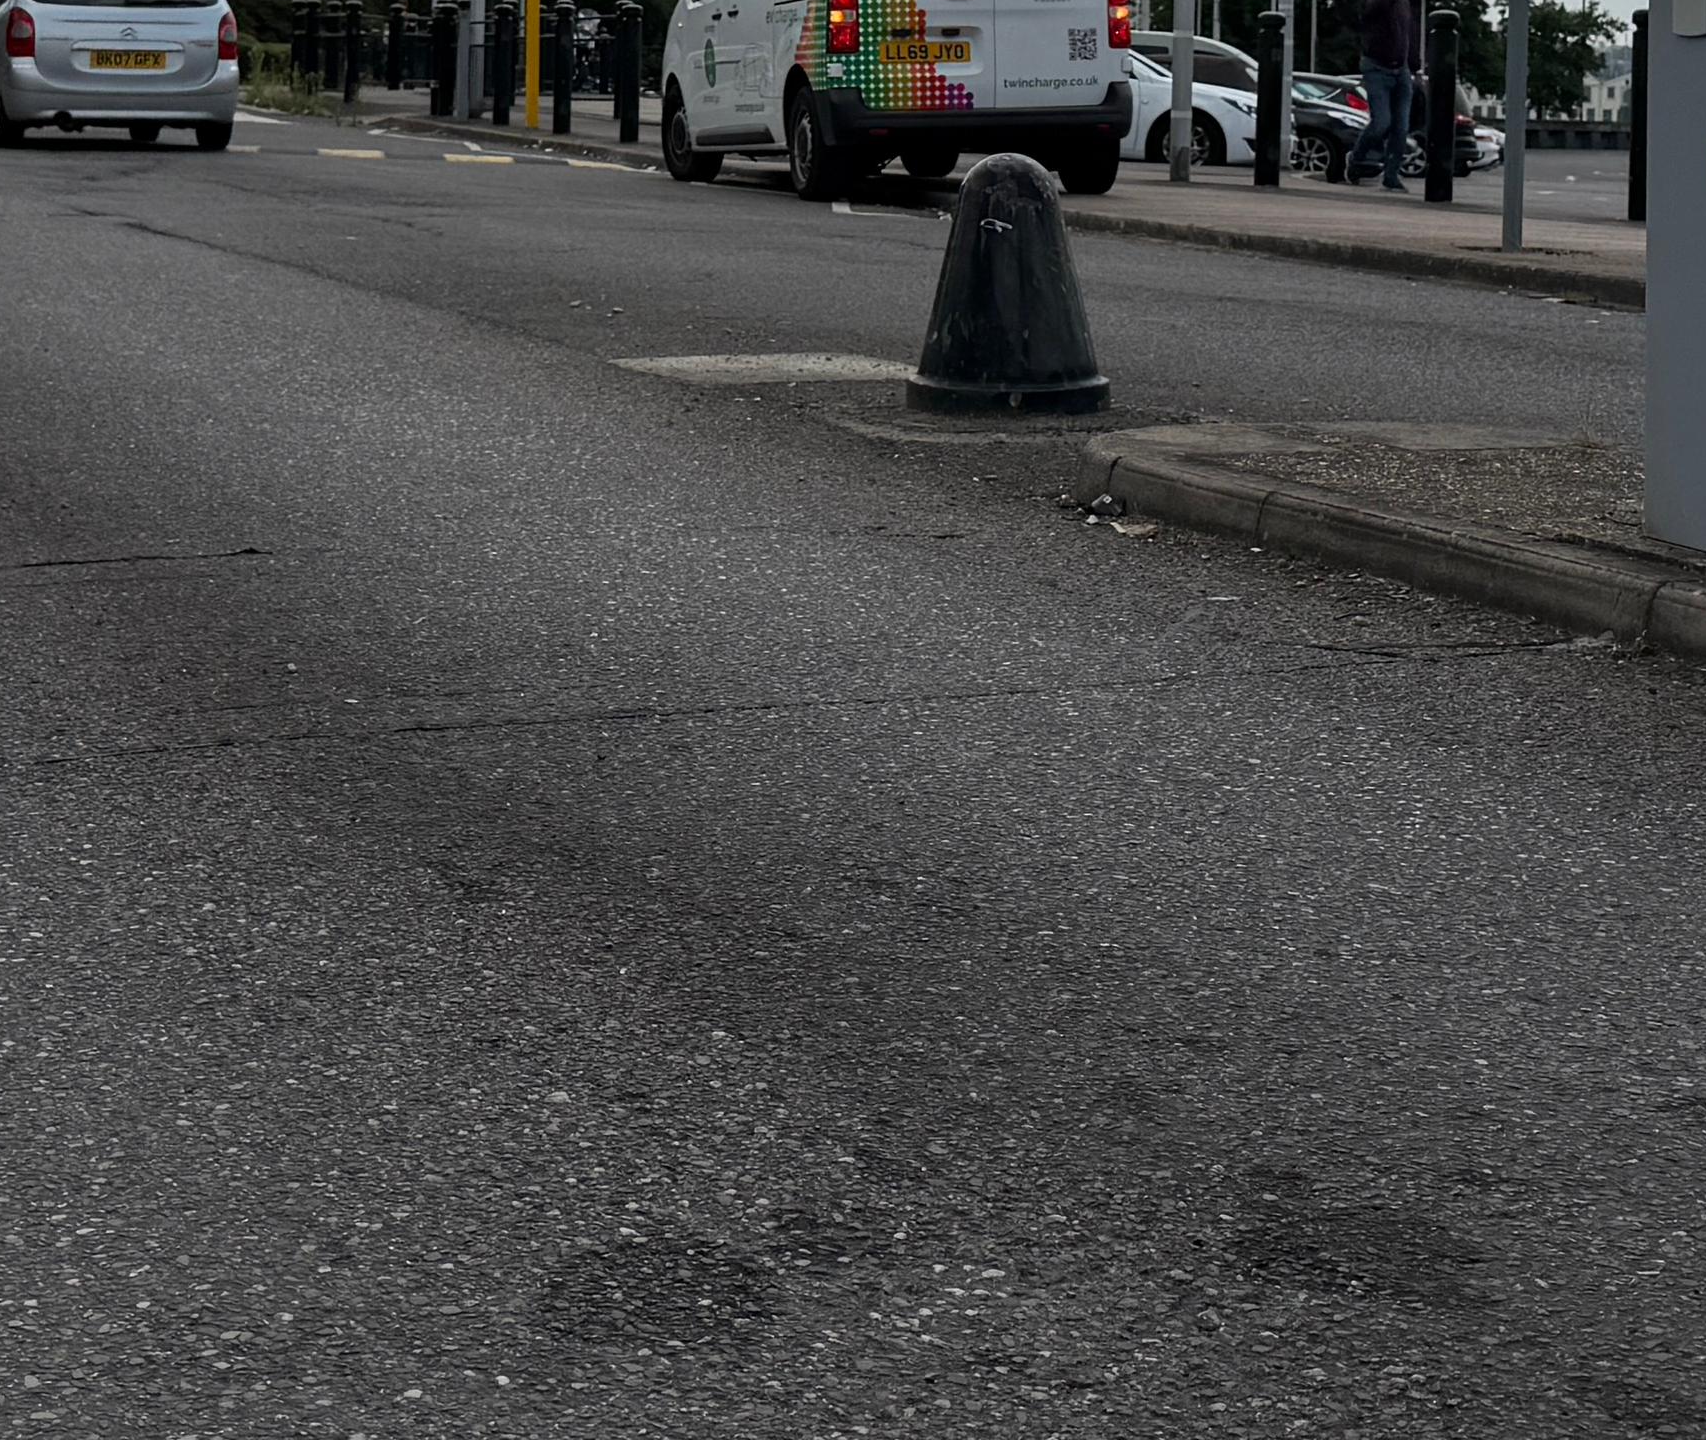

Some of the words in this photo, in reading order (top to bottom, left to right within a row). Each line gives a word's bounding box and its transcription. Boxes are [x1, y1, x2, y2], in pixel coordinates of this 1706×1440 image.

[886, 44, 929, 60] LL69
[933, 44, 964, 59] JYO
[1003, 76, 1099, 89] twincharge.co.uk
